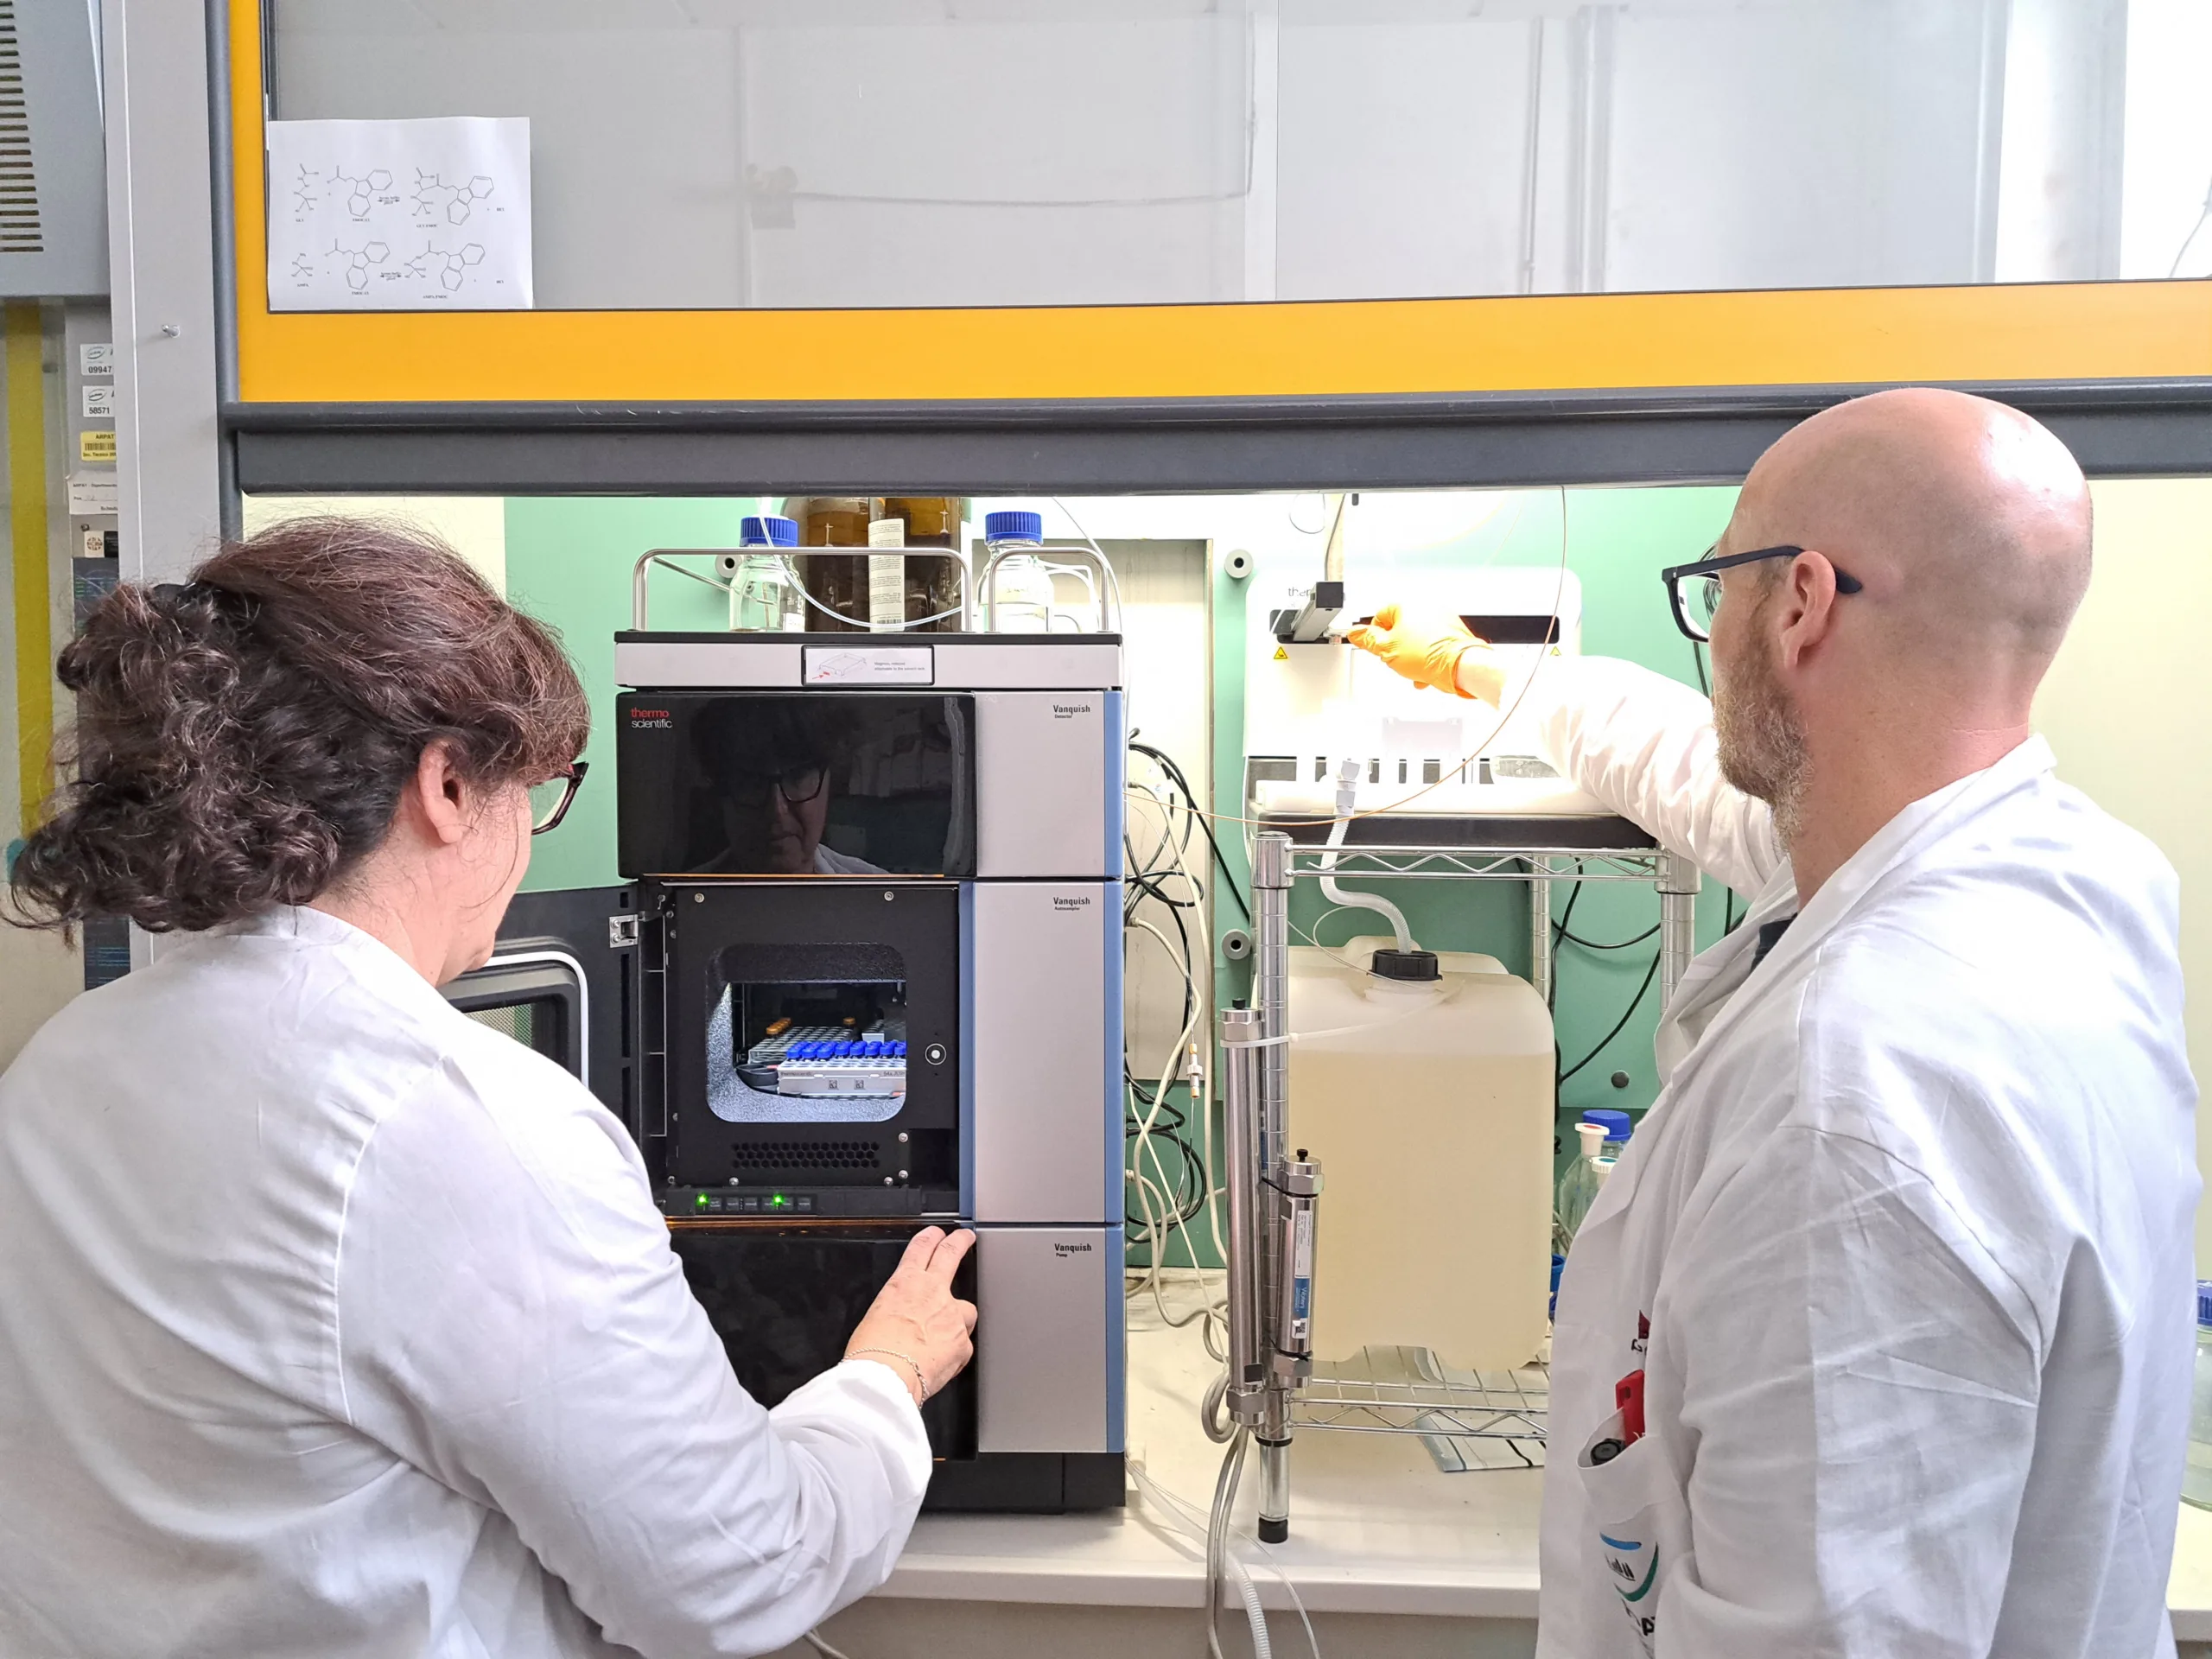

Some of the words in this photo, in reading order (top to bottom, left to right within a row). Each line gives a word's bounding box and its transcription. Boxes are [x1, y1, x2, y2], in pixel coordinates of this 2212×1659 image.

[88, 365, 112, 374] 09947
[89, 406, 110, 415] 58571
[631, 707, 670, 718] thermo
[1052, 704, 1090, 715] Vanquish
[631, 718, 673, 728] scientific
[1052, 896, 1090, 907] Vanquish
[1054, 1243, 1092, 1254] Vanquish
